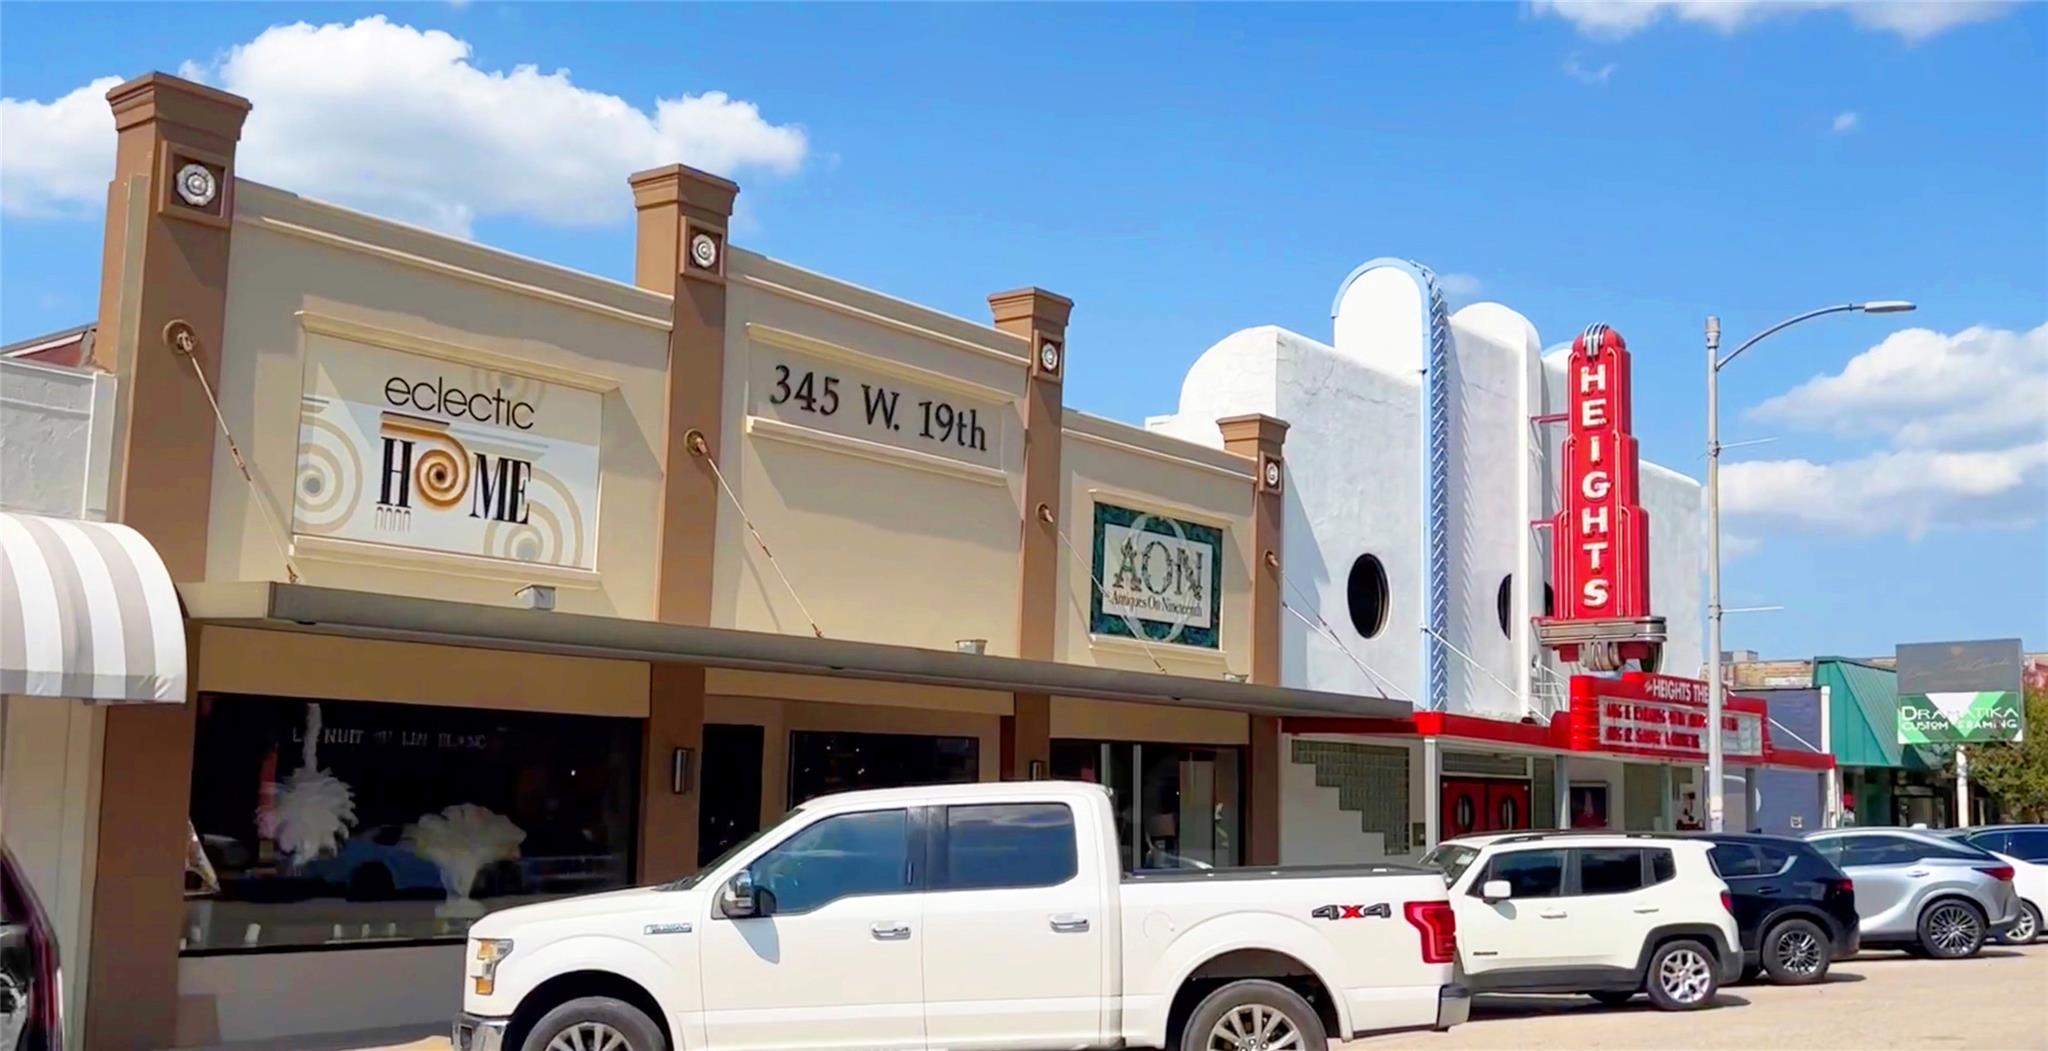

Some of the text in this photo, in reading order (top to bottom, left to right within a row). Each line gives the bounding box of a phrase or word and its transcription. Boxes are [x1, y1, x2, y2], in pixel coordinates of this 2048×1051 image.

[384, 376, 535, 429] eclectic
[769, 364, 987, 451] 345 W. 19th
[1580, 364, 1612, 606] HEIGHTS
[1112, 537, 1203, 601] AON
[1652, 678, 1692, 702] HEIGHTS
